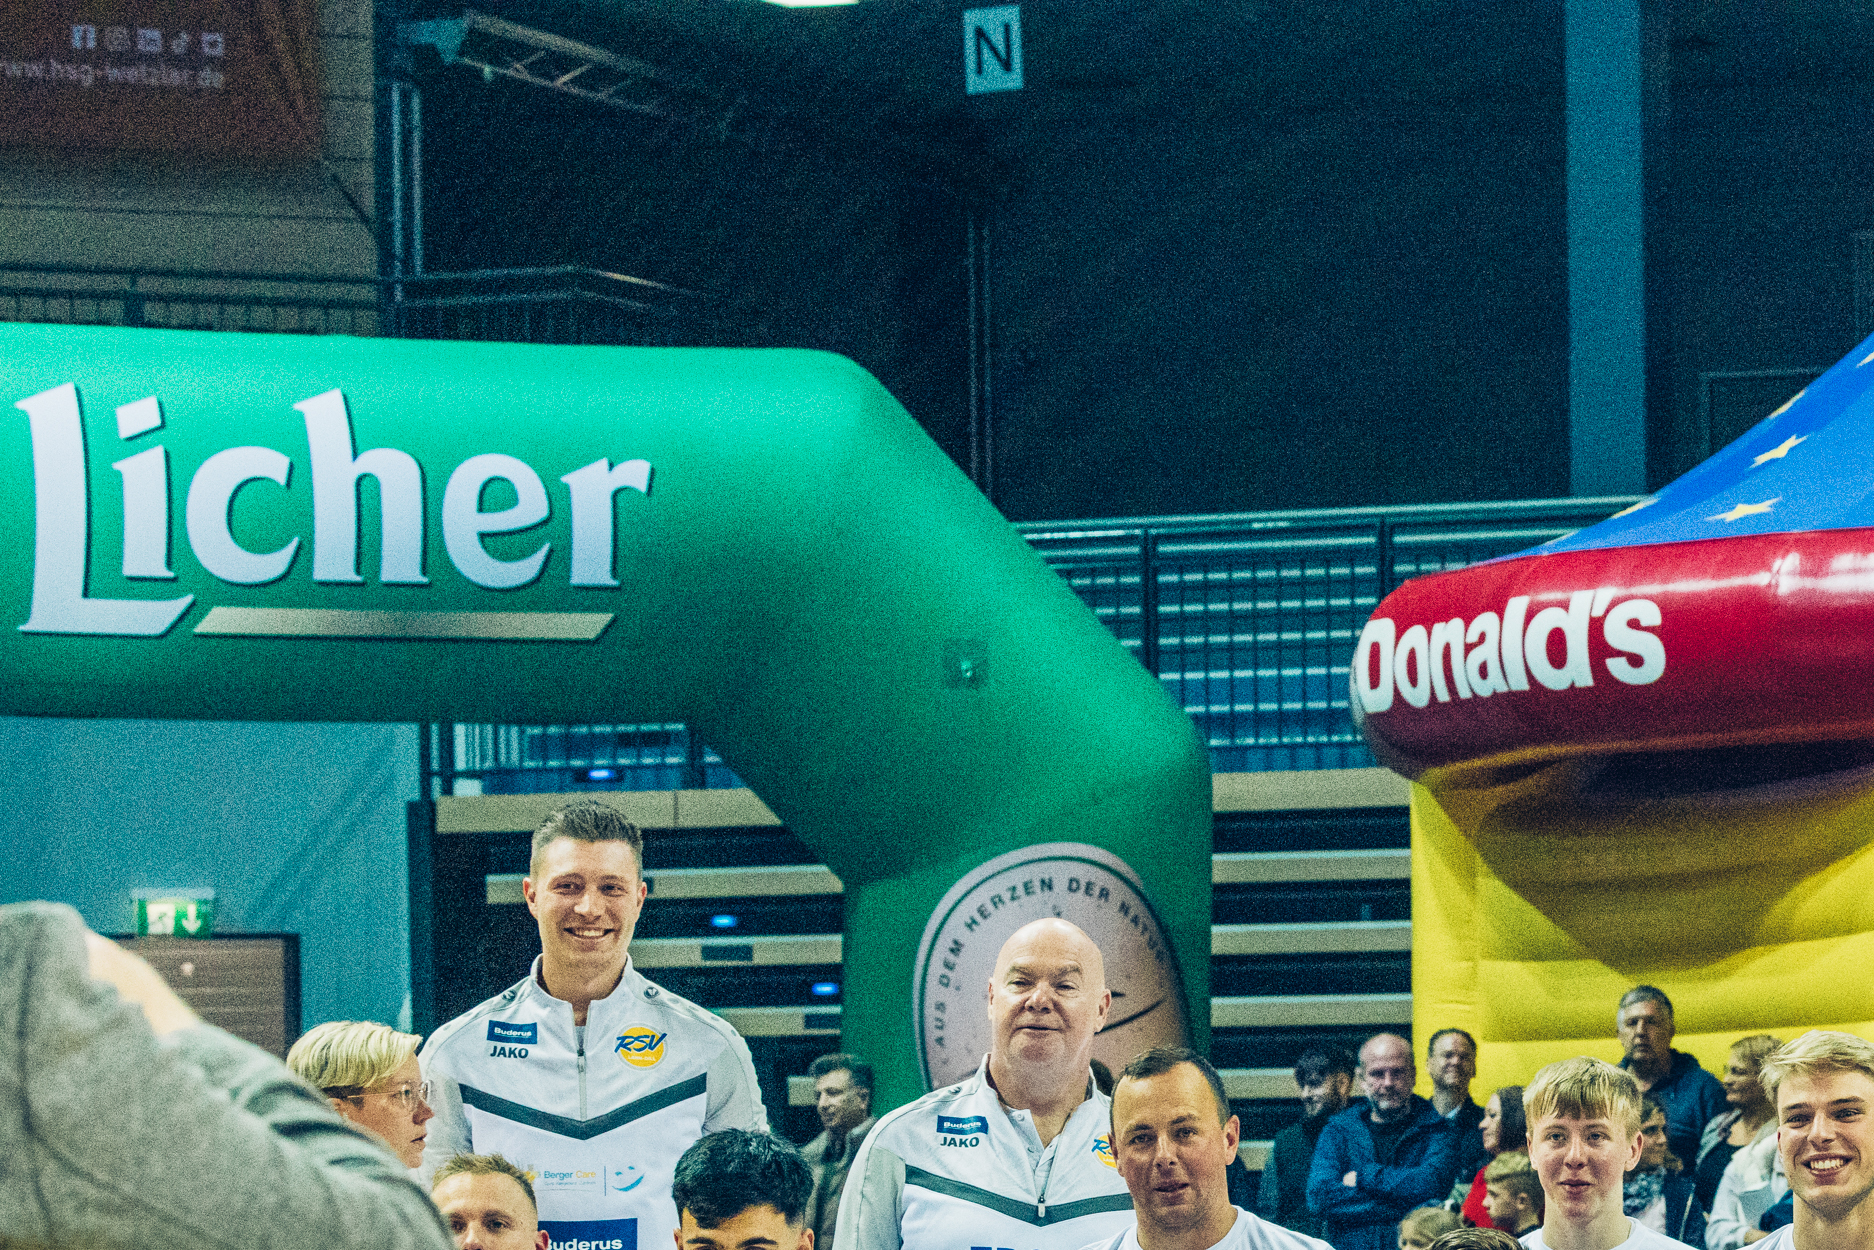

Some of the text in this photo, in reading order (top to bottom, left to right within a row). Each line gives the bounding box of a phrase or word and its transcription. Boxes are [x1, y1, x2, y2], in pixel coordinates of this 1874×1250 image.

[973, 21, 1013, 76] N
[12, 382, 654, 638] Licher
[963, 876, 1055, 933] HERZEN
[1067, 876, 1111, 903] DER
[494, 1027, 532, 1037] Buderus
[614, 1032, 668, 1053] RSV
[490, 1045, 529, 1059] JAKO
[940, 1136, 980, 1148] JAKO
[543, 1170, 597, 1181] Berger Care
